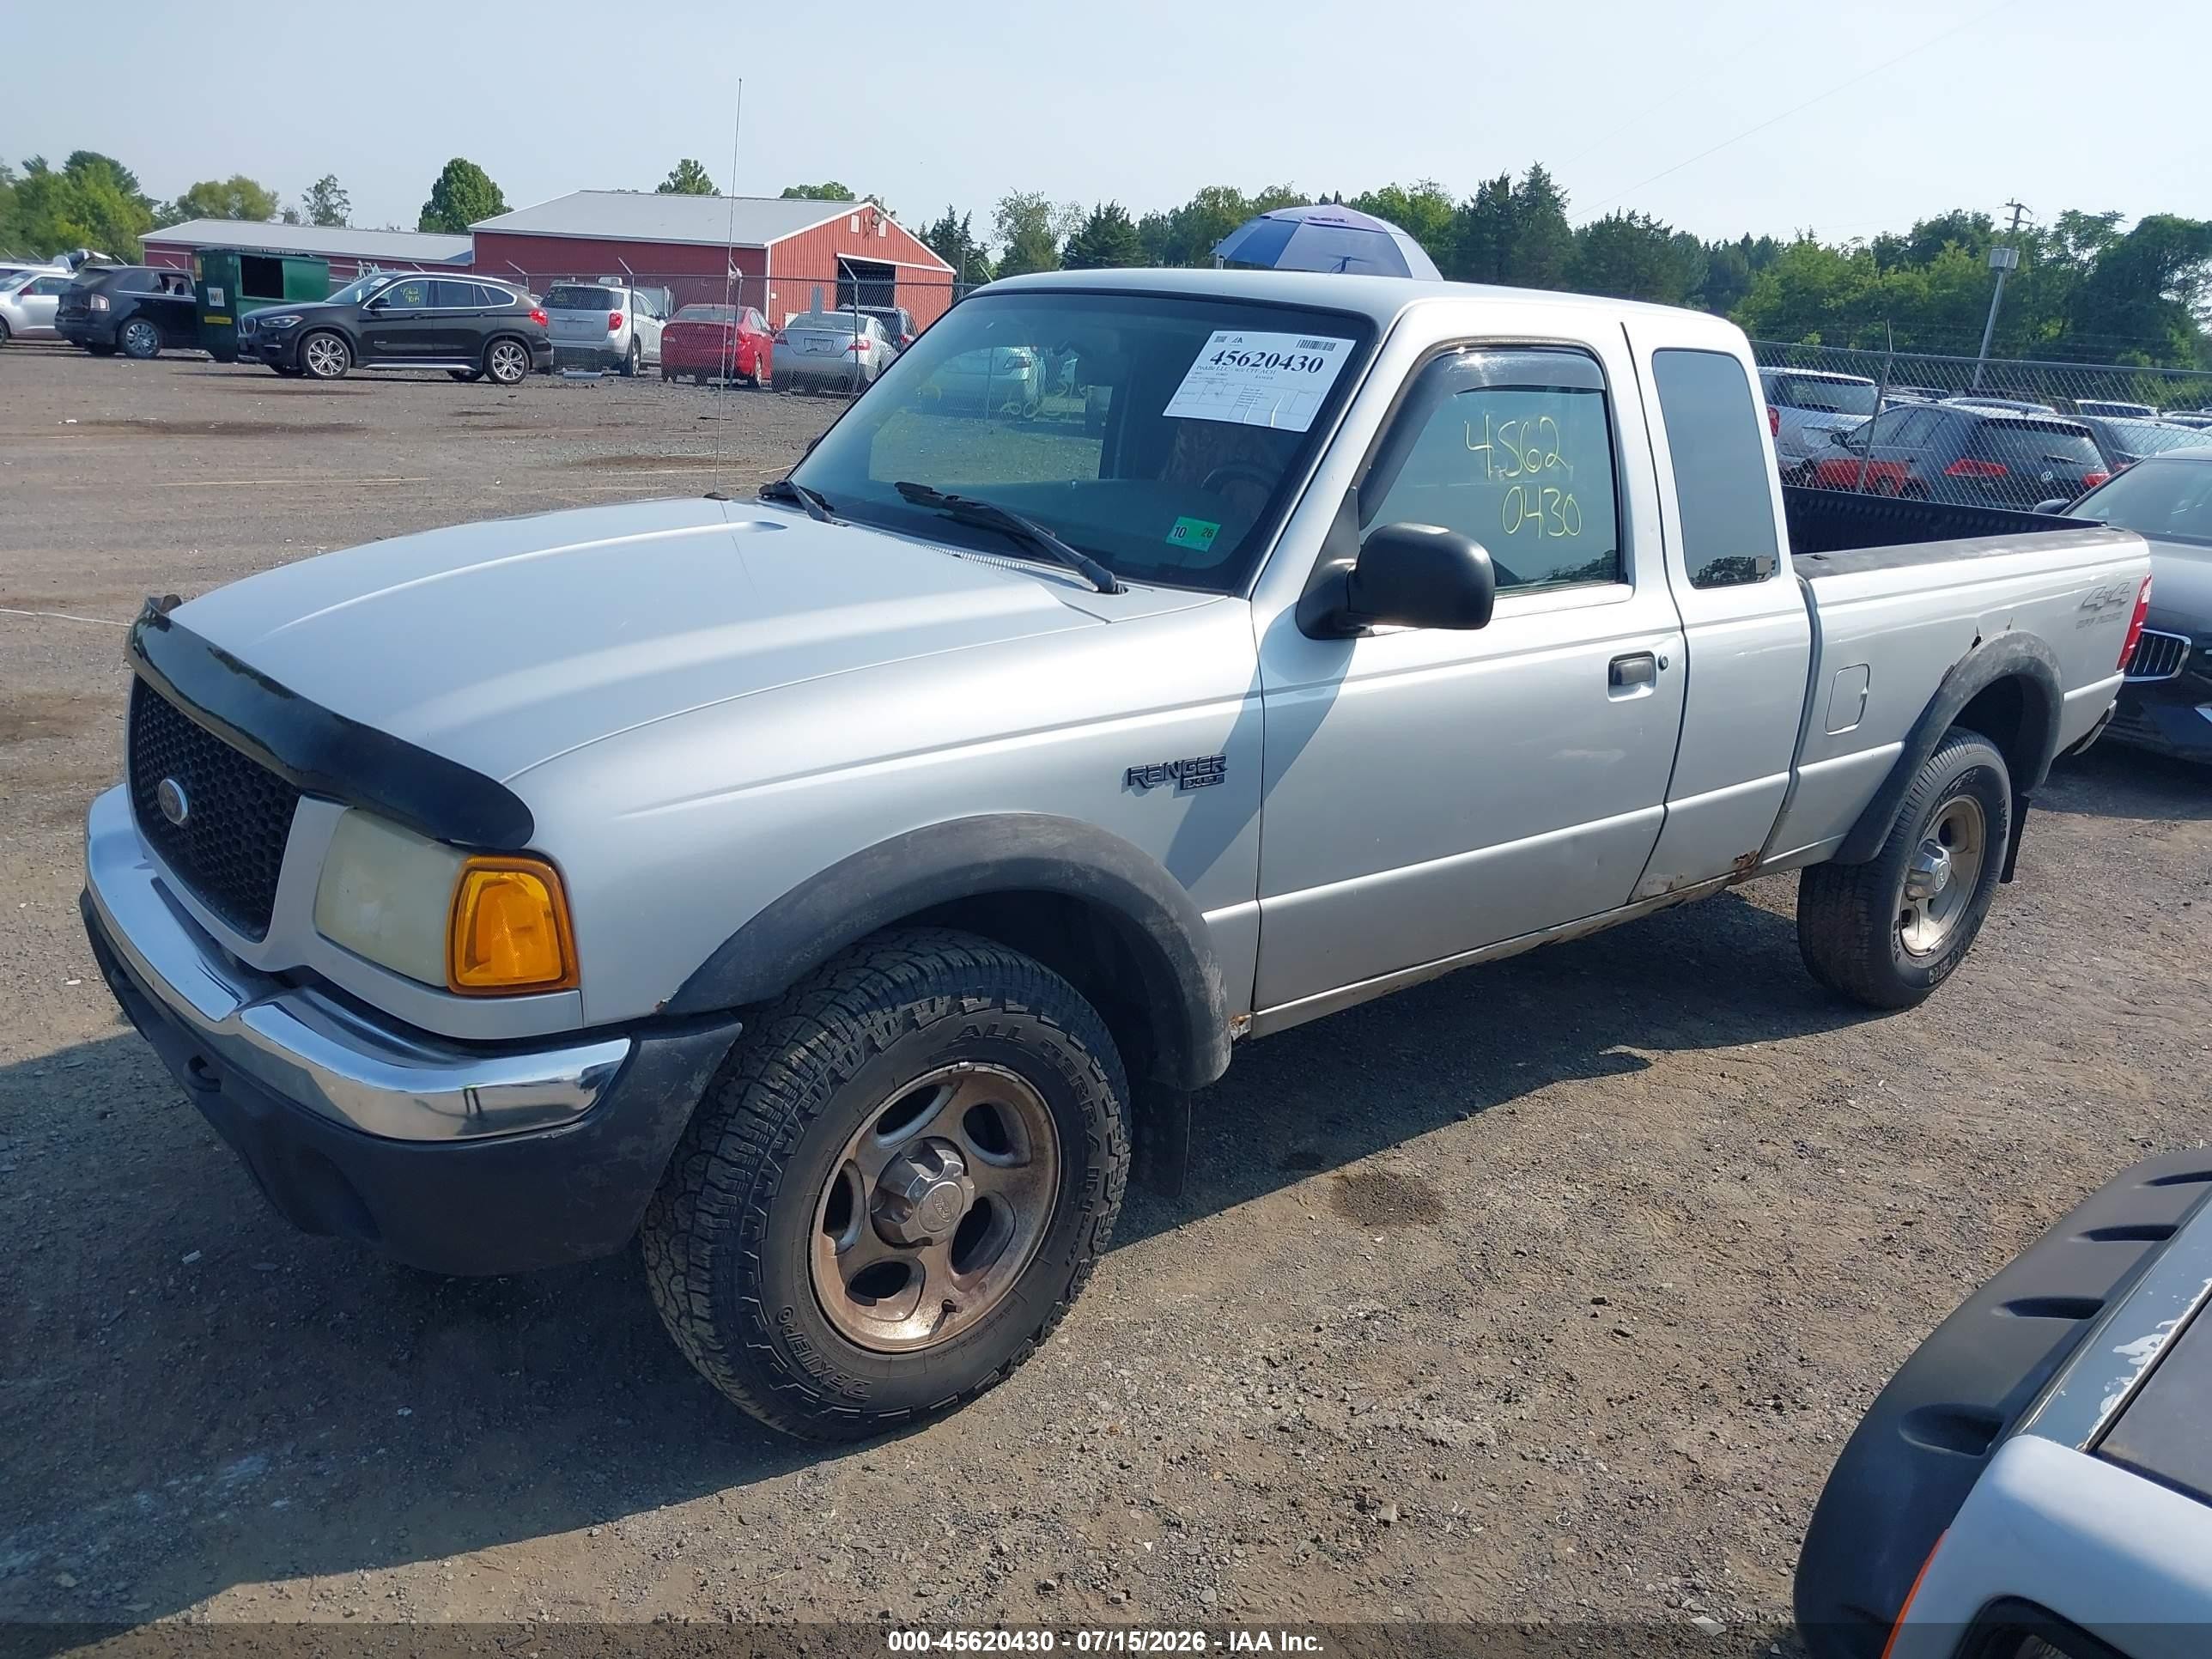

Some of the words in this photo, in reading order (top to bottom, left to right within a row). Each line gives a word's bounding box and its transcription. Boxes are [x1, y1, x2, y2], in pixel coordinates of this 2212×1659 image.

[1210, 349, 1324, 374] 45620430
[1464, 415, 1572, 477] 4562
[1174, 526, 1188, 538] 10
[1202, 527, 1215, 538] 26
[1503, 486, 1581, 538] 0430
[1127, 755, 1228, 789] RANGER
[953, 1022, 1026, 1042] ALL
[1039, 1038, 1100, 1211] TERRAIN
[775, 1305, 873, 1401] DEXTERO
